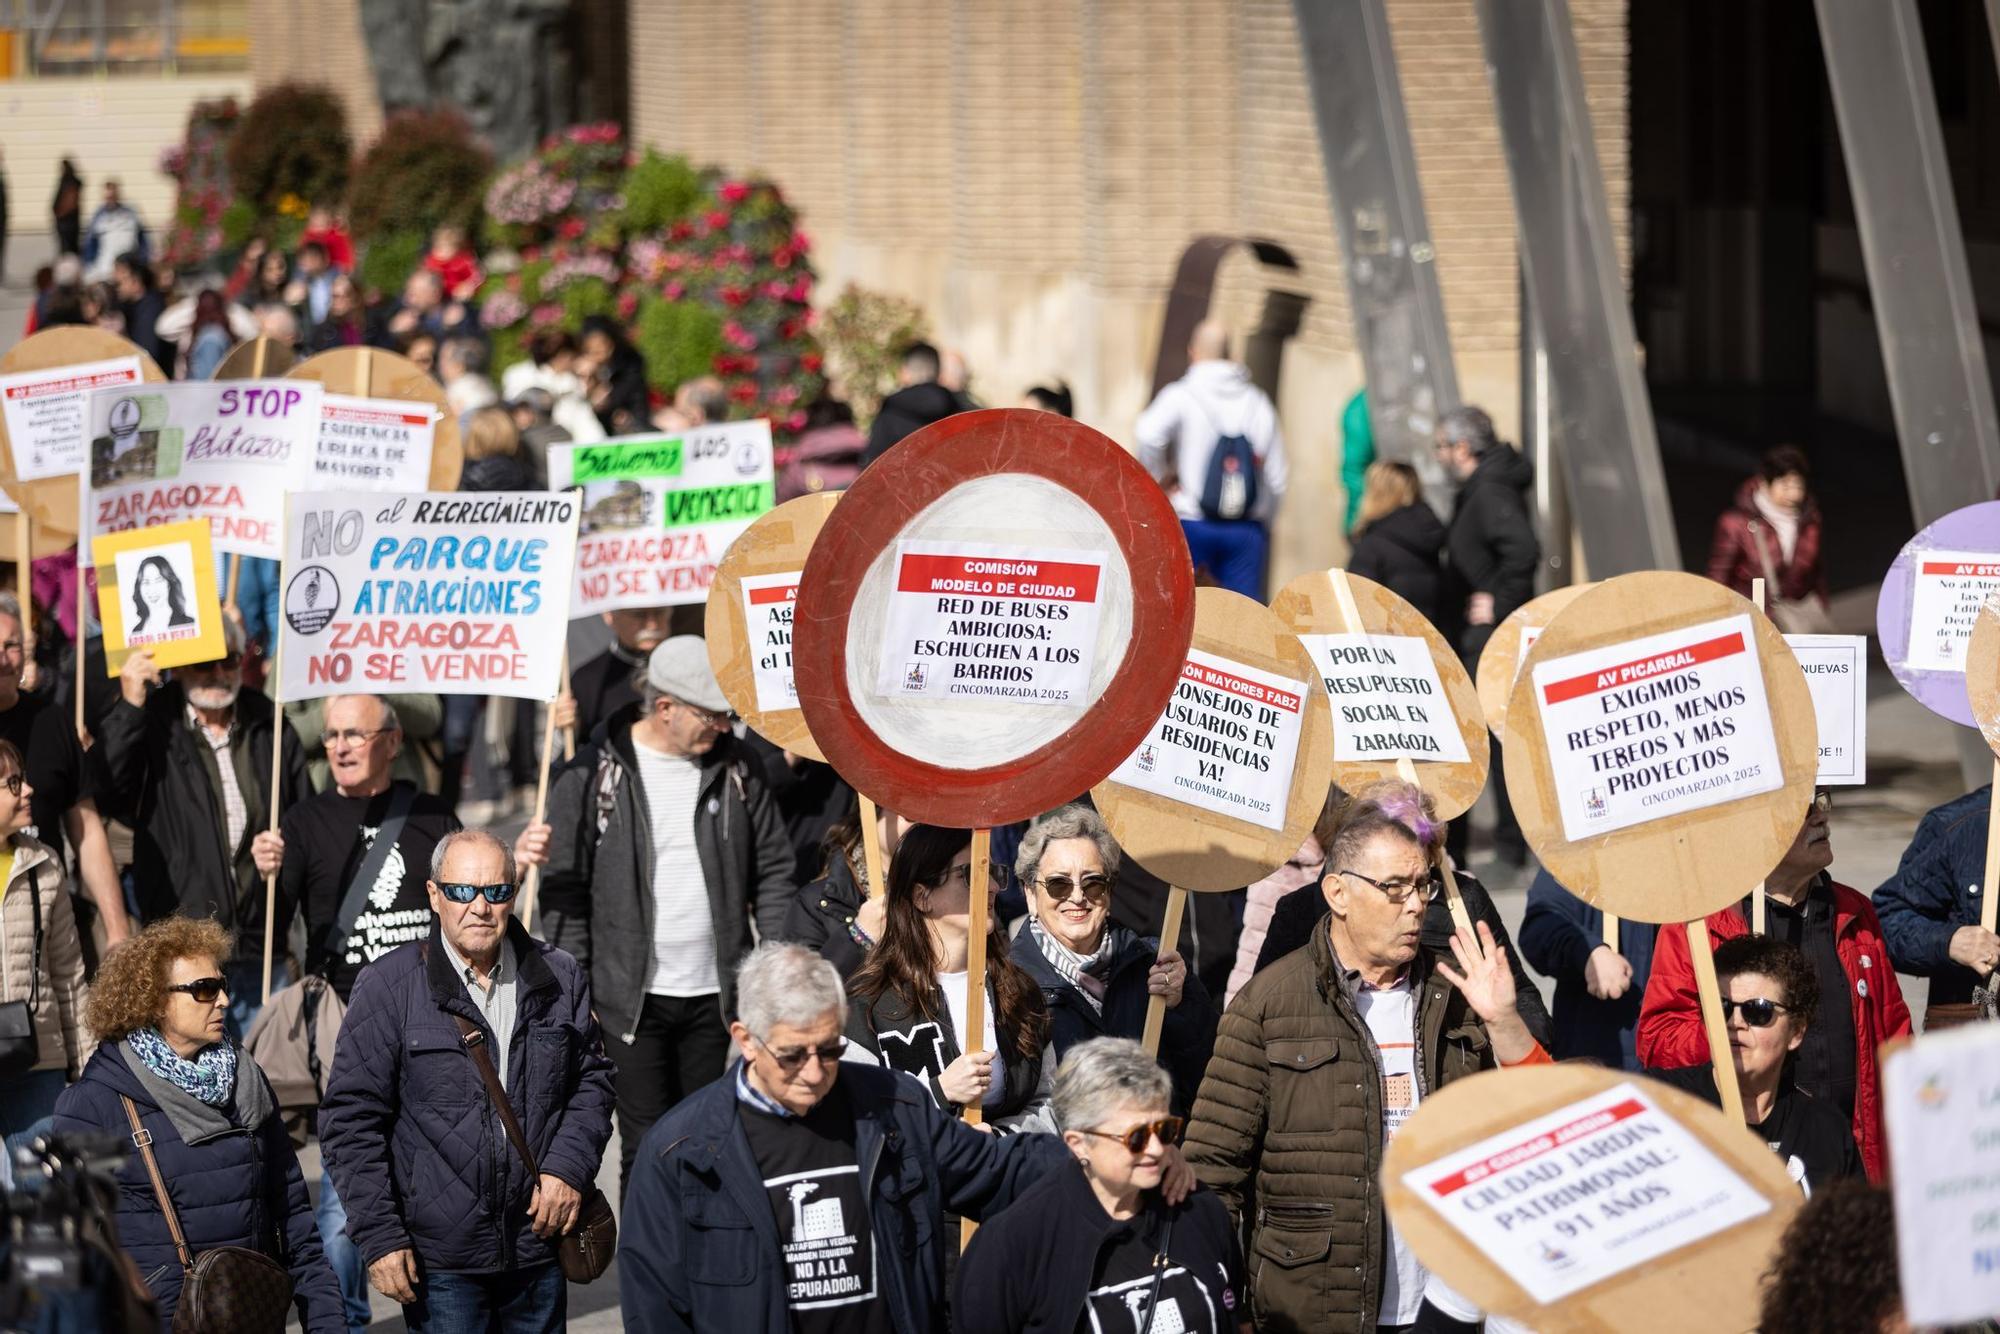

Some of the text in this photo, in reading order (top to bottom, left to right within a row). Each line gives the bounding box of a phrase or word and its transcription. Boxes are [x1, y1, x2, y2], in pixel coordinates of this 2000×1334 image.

[218, 389, 302, 417] STOP
[97, 485, 244, 523] ZARAGOZA
[300, 509, 364, 560] NO
[376, 498, 407, 523] al
[369, 535, 548, 572] PARQUE
[580, 534, 709, 569] ZARAGOZA
[581, 562, 718, 602] NO SE VEND
[963, 561, 1038, 577] COMISIÓN
[1954, 565, 1975, 575] AV
[930, 578, 1076, 599] MODELO DE CIUDAD
[1940, 579, 1955, 588] No
[1960, 580, 1971, 589] al
[1961, 592, 1979, 601] las
[768, 606, 793, 626] Ag
[936, 597, 1070, 621] RED DE BUSES
[329, 621, 520, 650] ZARAGOZA
[946, 619, 1053, 642] AMBICIOSA:
[1936, 628, 1951, 637] de
[761, 652, 778, 670] el
[913, 639, 1081, 665] ESCHUCHEN A LOS
[1330, 646, 1397, 666] POR UN
[308, 653, 528, 684] NO SE VENDE
[953, 663, 1034, 684] BARRIOS
[1597, 651, 1696, 689] AV PICARRAL
[950, 683, 1070, 701] CINCOMARZADA 2025
[1181, 663, 1299, 711] ÓN MAYORES FABZ
[1324, 674, 1433, 696] RESUPUESTO
[1600, 671, 1701, 715] EXIGIMOS
[1164, 701, 1277, 752] USUARIOS EN
[1257, 706, 1282, 730] DE
[1341, 703, 1430, 724] SOCIAL EN
[1567, 686, 1746, 752] RESPETO, MENOS
[1352, 733, 1441, 752] ZARAGOZA
[1673, 730, 1686, 750] Y
[1693, 715, 1736, 746] MÁS
[1160, 723, 1272, 774] RESIDENCIAS
[1198, 758, 1226, 784] YA!
[1607, 746, 1730, 796] PROYECTOS
[1174, 775, 1272, 814] CINCOMARZADA 2025
[1641, 765, 1762, 807] CINCOMARZADA 2025
[353, 909, 432, 931] alvemos
[1461, 1159, 1563, 1213] CIUDAD
[1494, 1147, 1680, 1232] PATRIMONIAL:
[1554, 1212, 1595, 1238] 91
[828, 1234, 858, 1248] VECINAL
[794, 1257, 848, 1280] NO A LA
[789, 1274, 862, 1299] EPURADORA
